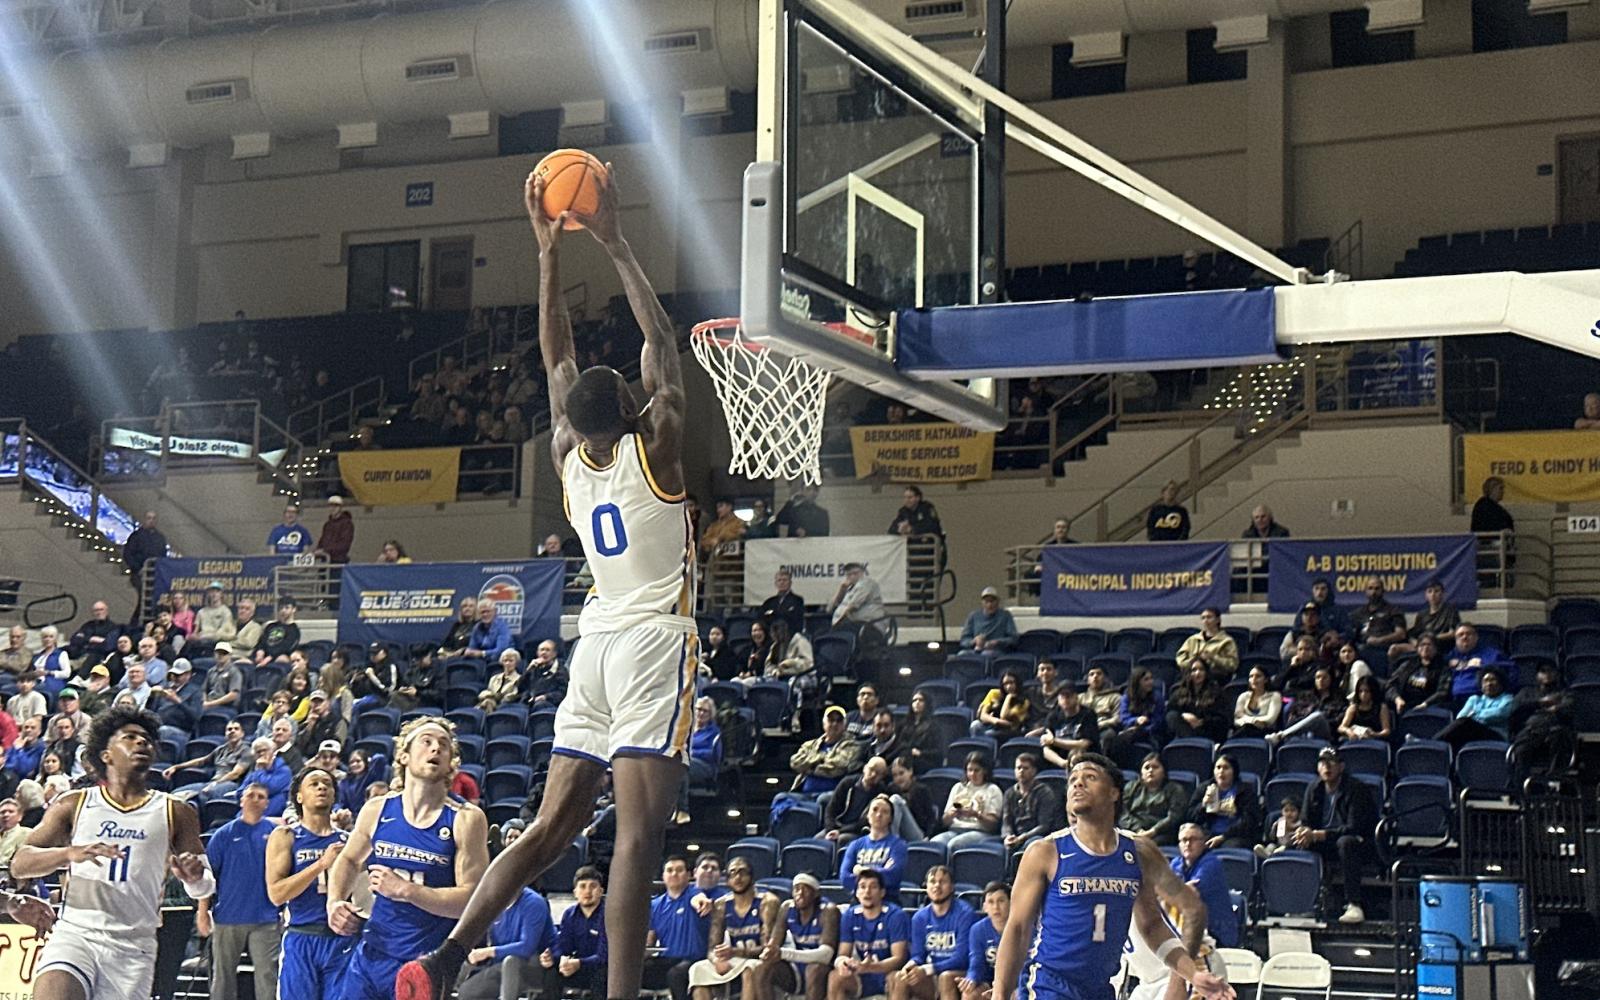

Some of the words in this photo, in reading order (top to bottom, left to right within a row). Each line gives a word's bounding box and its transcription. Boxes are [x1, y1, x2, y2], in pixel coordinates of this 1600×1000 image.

[408, 188, 431, 202] 202
[864, 429, 922, 442] BERKSHIRE
[924, 427, 978, 440] HATHAWAY
[877, 447, 909, 460] HOME
[911, 446, 960, 460] SERVICES
[926, 463, 977, 478] REALTORS
[1491, 461, 1526, 475] FERD
[1530, 460, 1539, 474] &
[1543, 458, 1585, 474] CINDY
[363, 470, 393, 482] CURRY
[395, 468, 432, 482] DAWSON
[592, 502, 628, 557] 0
[1570, 518, 1597, 530] 104
[198, 560, 244, 575] LEGRAND
[296, 554, 313, 566] 103
[1306, 555, 1332, 572] A-B
[1335, 552, 1437, 572] DISTRIBUTING
[235, 576, 269, 590] RANCH
[1057, 572, 1128, 591] PRINCIPAL
[1131, 570, 1213, 590] INDUSTRIES
[1336, 574, 1407, 593] COMANY
[361, 596, 402, 609] BLUE
[410, 595, 452, 609] GOLD
[96, 821, 149, 840] Rams
[1092, 903, 1107, 942] 1
